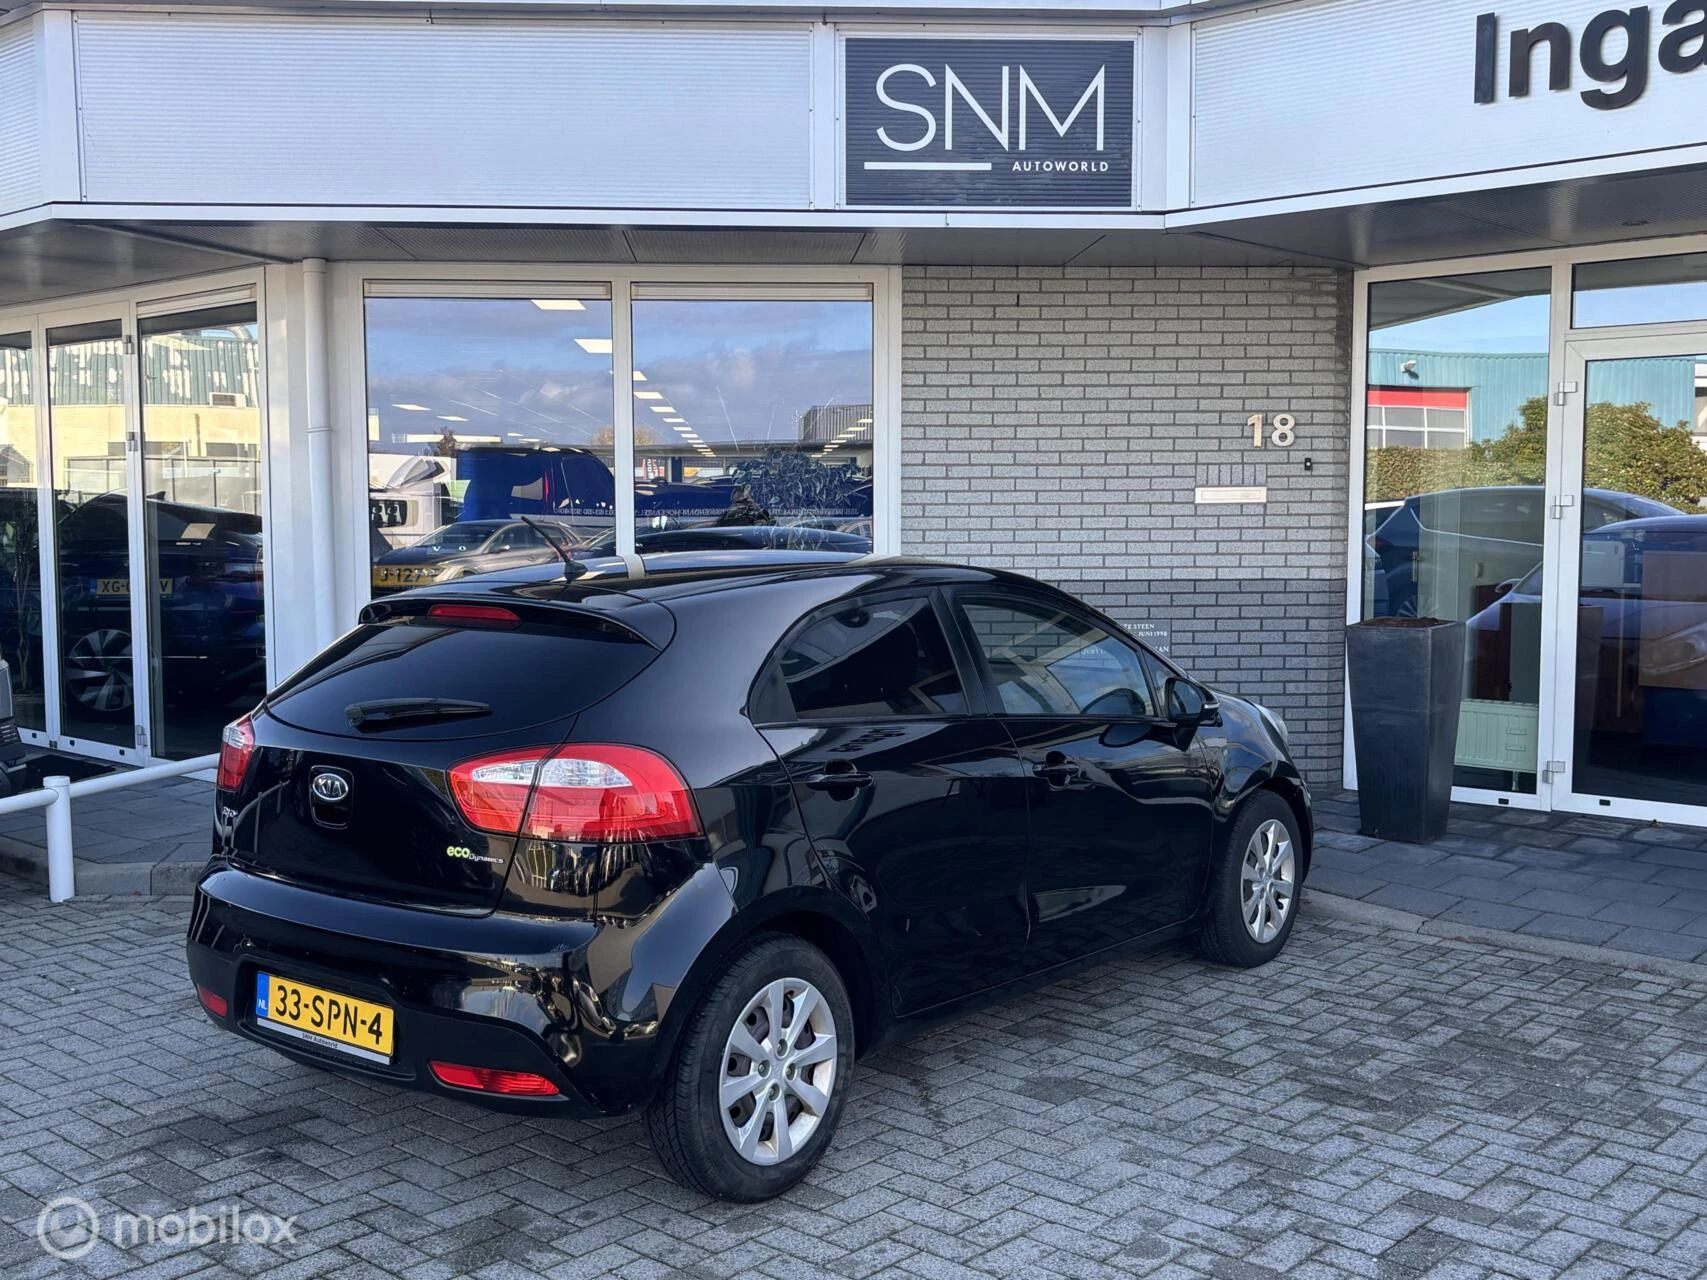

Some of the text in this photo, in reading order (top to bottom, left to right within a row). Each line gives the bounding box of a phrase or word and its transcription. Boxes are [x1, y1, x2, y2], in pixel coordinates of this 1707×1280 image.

[1474, 0, 1707, 110] Inga
[876, 63, 1105, 151] SNM
[1012, 161, 1109, 172] AUTOWORLD
[1247, 413, 1295, 448] 18
[317, 778, 343, 796] KIA
[258, 998, 267, 1010] NL
[275, 984, 383, 1045] 33-SPN-4
